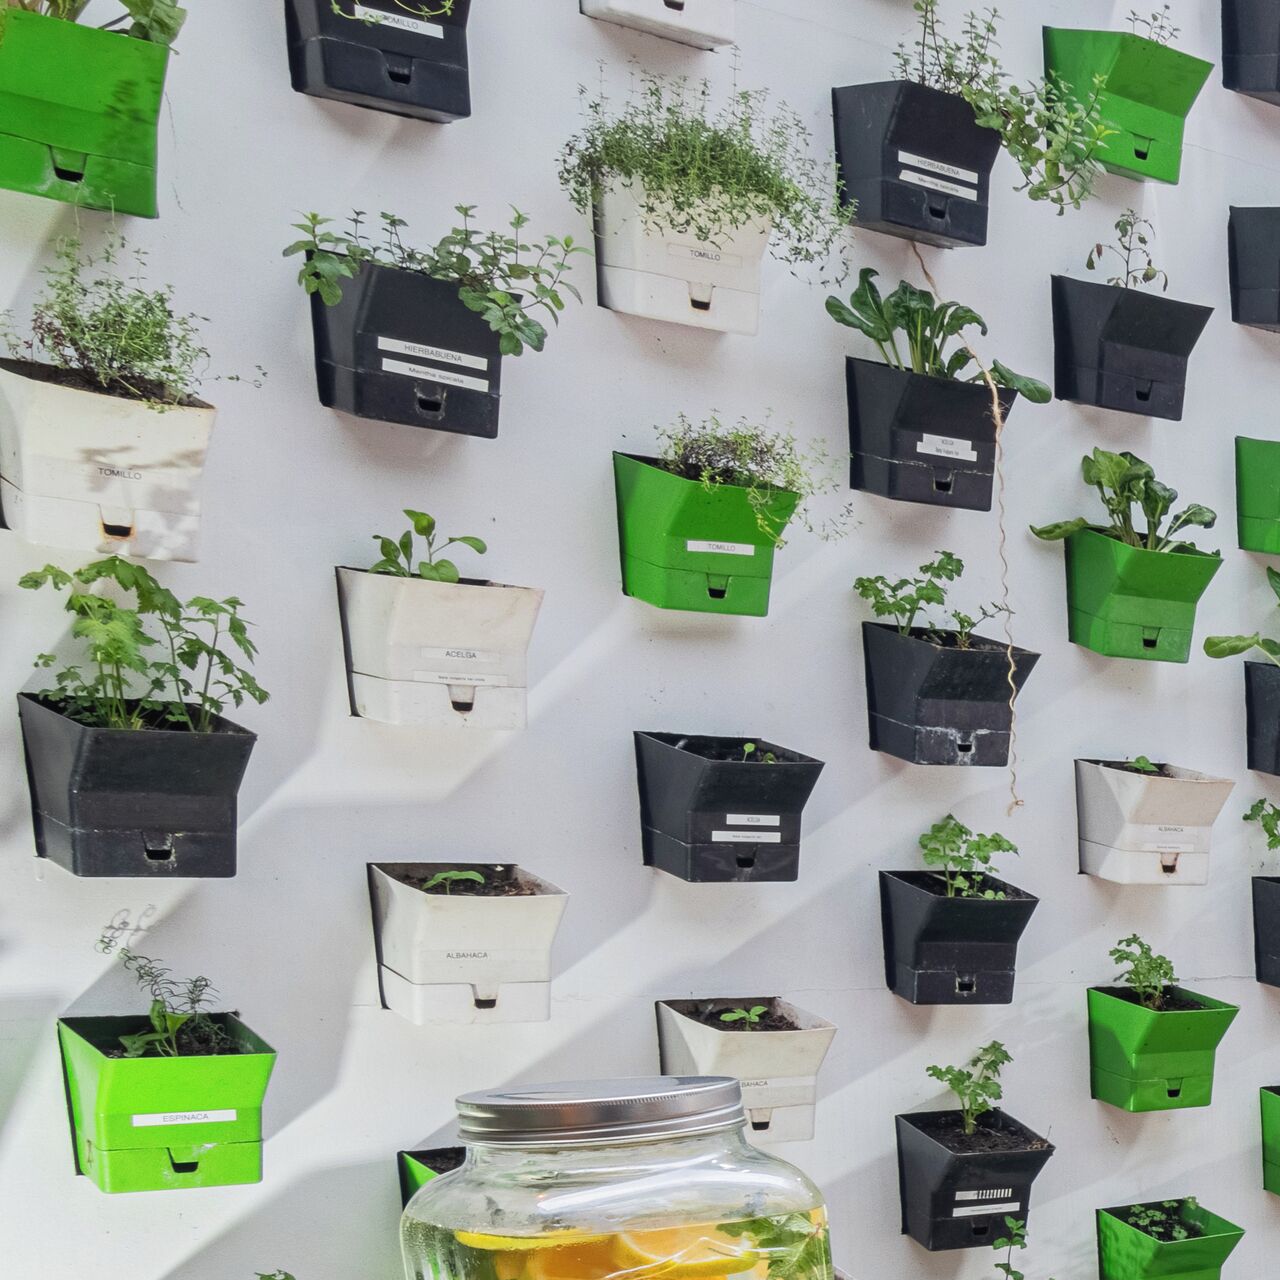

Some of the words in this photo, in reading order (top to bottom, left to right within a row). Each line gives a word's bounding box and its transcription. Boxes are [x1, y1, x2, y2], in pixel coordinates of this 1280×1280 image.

[690, 249, 721, 261] TOMILLO
[404, 344, 463, 363] HIERBABUENA
[97, 467, 142, 481] TOMILLO
[708, 543, 736, 553] TOMILLO
[445, 650, 477, 659] ACELGA
[446, 952, 488, 960] ALBAHACA
[741, 1080, 768, 1088] BAHACA
[162, 1113, 209, 1123] ESPINACA
